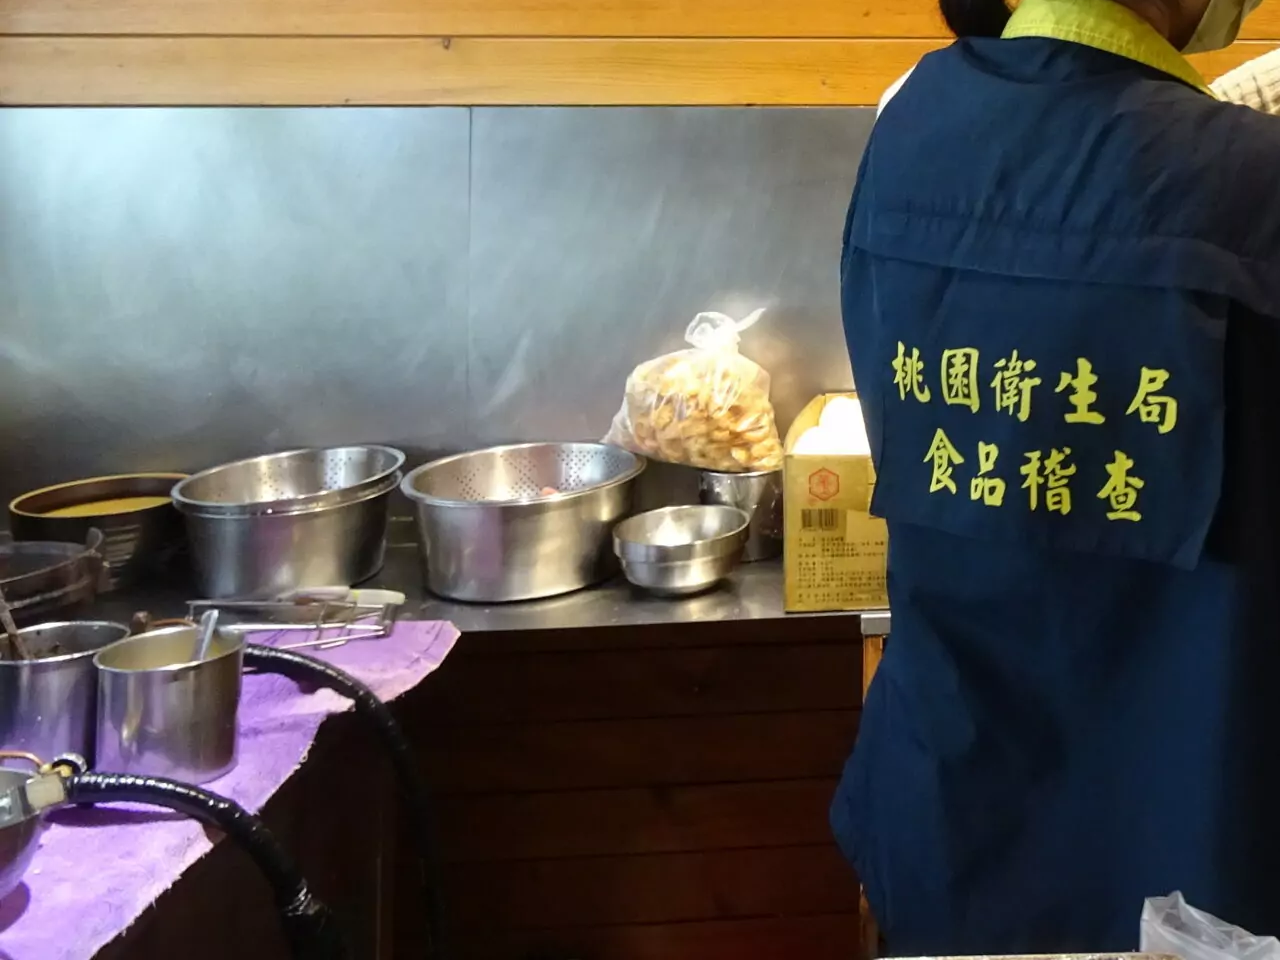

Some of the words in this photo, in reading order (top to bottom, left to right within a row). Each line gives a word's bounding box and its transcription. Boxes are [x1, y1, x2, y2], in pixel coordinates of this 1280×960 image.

[891, 340, 1178, 435] 桃園衛生局
[923, 427, 1145, 523] 食品稽查
